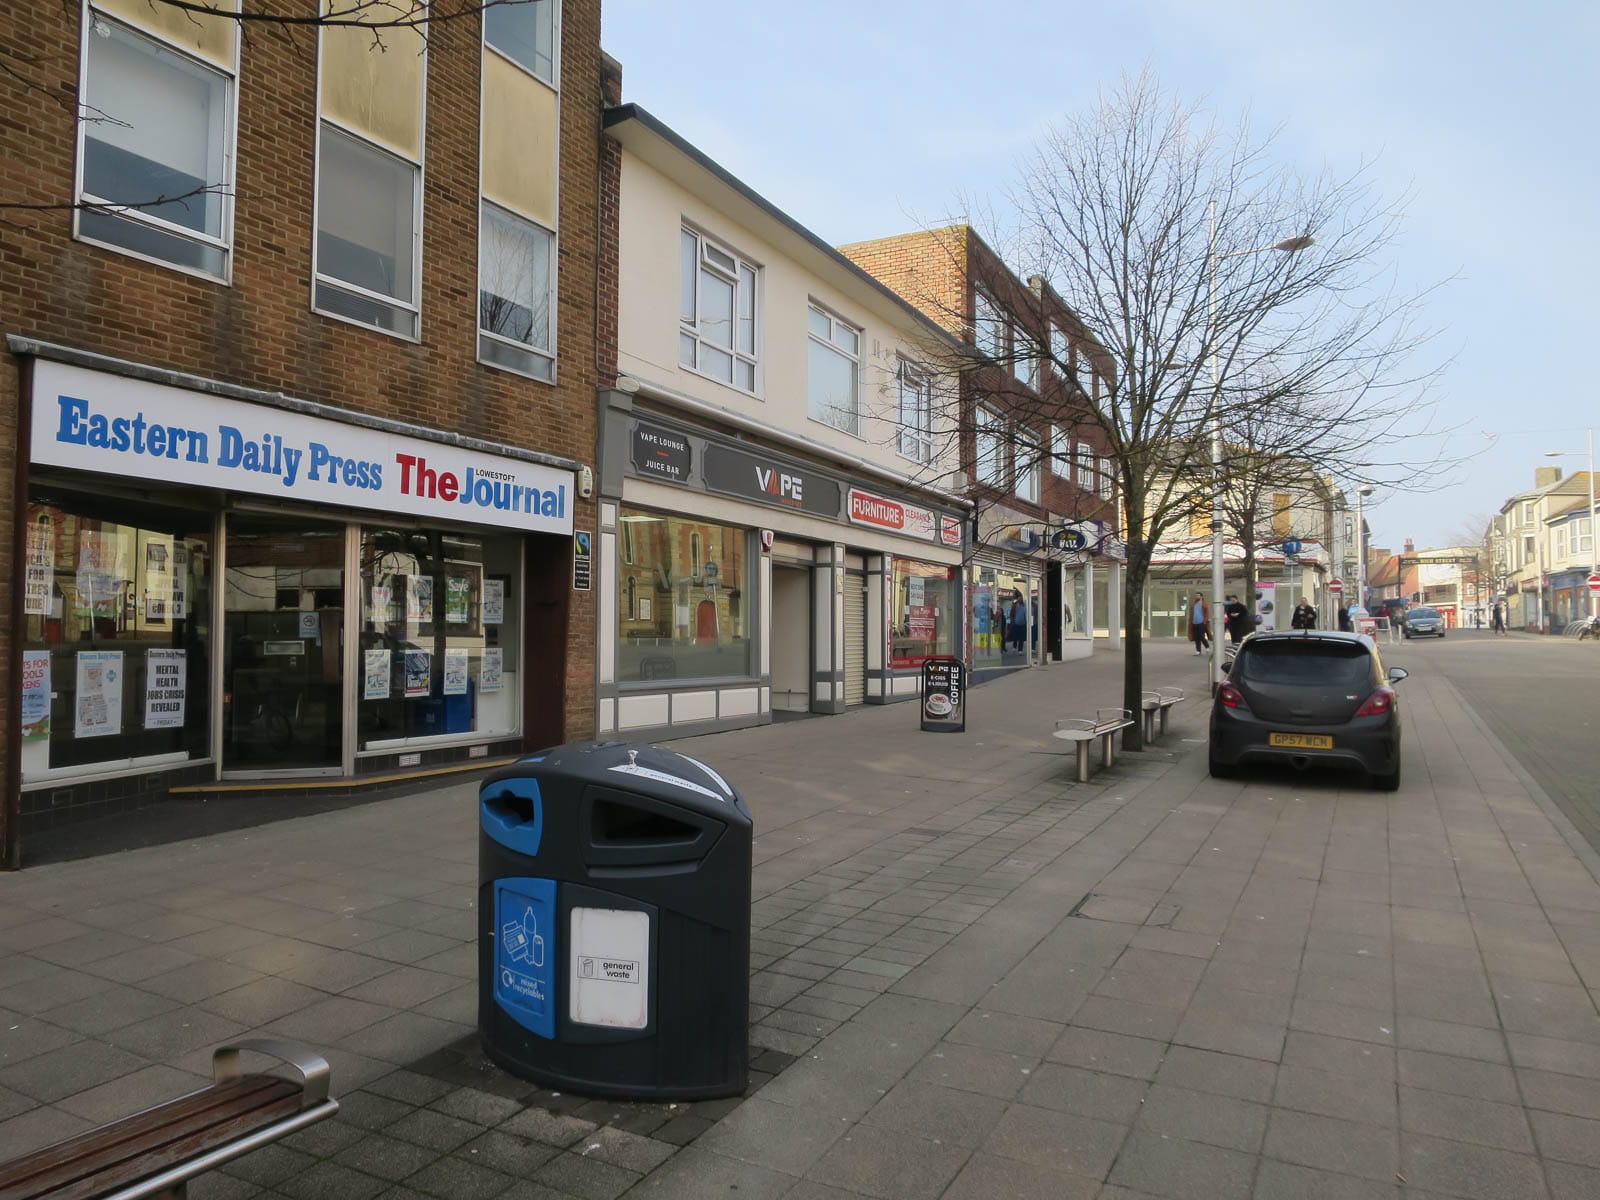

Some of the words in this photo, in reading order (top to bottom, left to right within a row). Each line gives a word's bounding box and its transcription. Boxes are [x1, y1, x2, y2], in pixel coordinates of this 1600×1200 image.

[56, 395, 208, 464] Eastern
[217, 424, 302, 486] Daily
[307, 442, 382, 491] Press
[640, 432, 658, 444] VAPE
[659, 437, 685, 451] LOUNGE
[645, 459, 665, 471] JUICE
[666, 464, 680, 475] BAR
[475, 469, 516, 482] LOWESTOFT
[396, 453, 458, 501] The
[459, 467, 565, 518] Journal
[755, 466, 803, 500] VAPE
[853, 498, 900, 523] FURNITURE
[448, 579, 469, 593] Save
[32, 659, 49, 668] FOR
[156, 665, 179, 674] MENTAL
[156, 677, 178, 687] HEALTH
[950, 666, 959, 705] COFFEE
[148, 690, 163, 700] JOBS
[164, 689, 185, 699] CRISIS
[151, 702, 180, 712] REVEALED
[603, 962, 634, 971] general
[607, 970, 630, 979] waste
[513, 985, 545, 1001] recyclables
